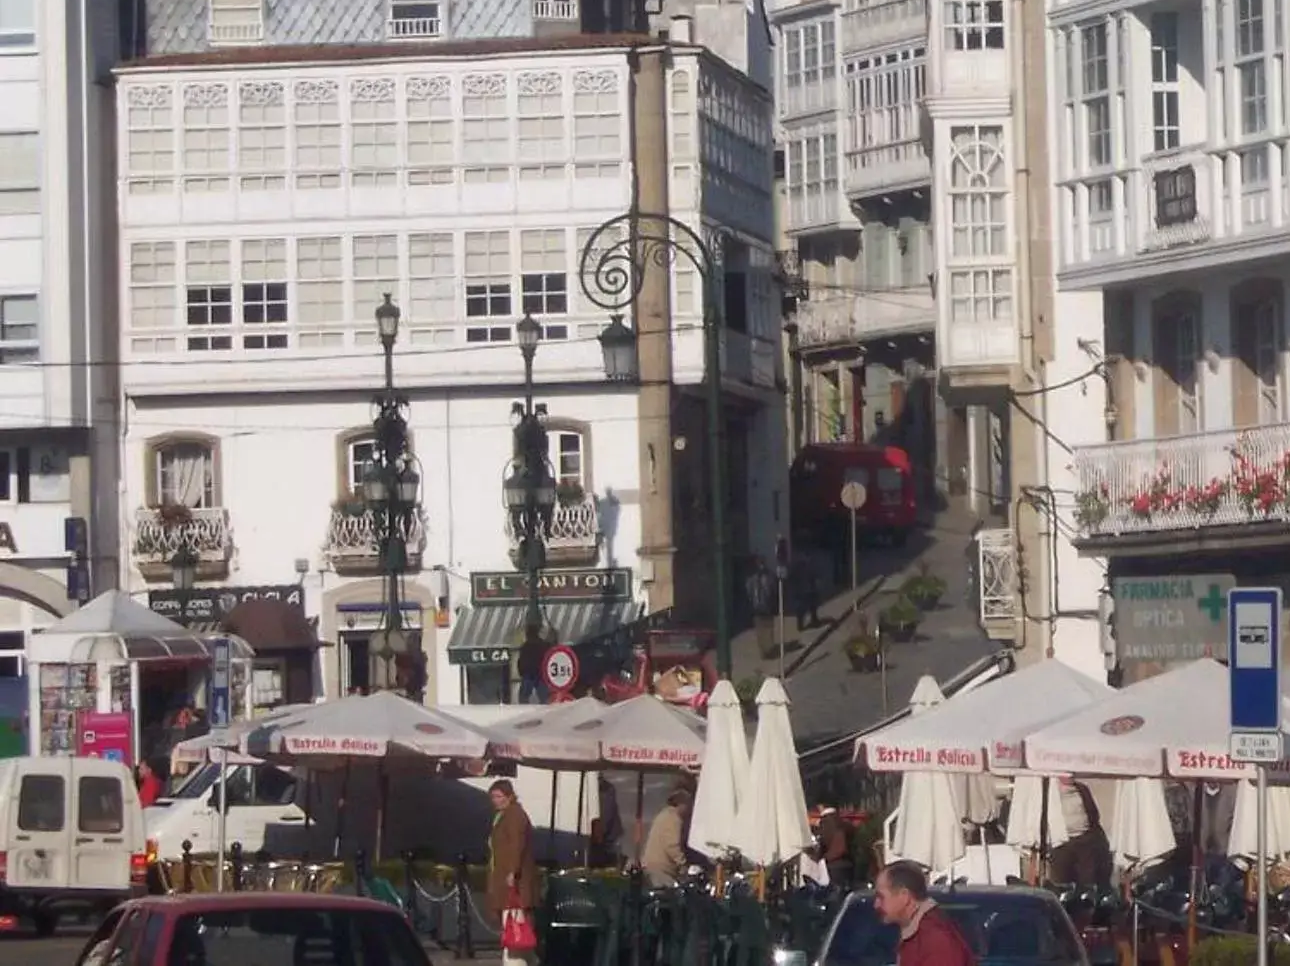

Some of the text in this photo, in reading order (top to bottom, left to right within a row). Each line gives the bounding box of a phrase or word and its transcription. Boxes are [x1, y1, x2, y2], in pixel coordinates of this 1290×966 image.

[486, 576, 512, 590] EL
[1120, 579, 1195, 601] FARMACIA
[609, 746, 654, 759] Estrella
[876, 745, 932, 765] Estrella
[937, 748, 977, 767] Galicia
